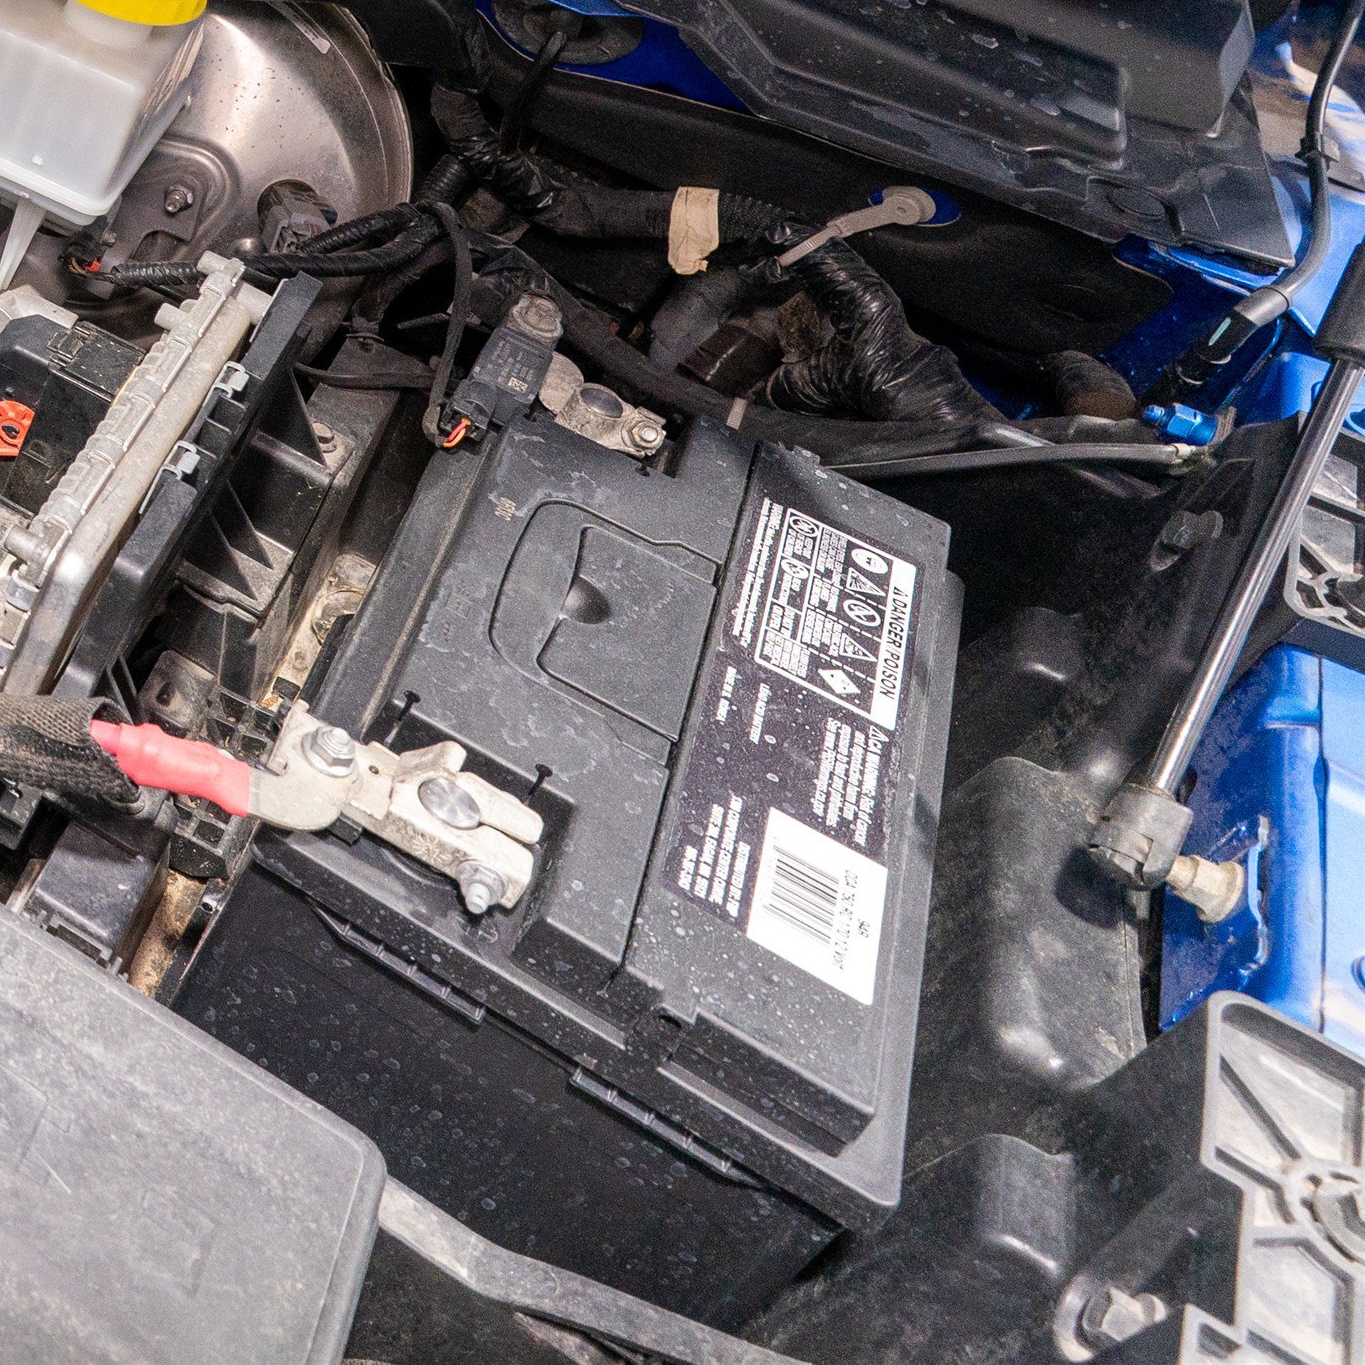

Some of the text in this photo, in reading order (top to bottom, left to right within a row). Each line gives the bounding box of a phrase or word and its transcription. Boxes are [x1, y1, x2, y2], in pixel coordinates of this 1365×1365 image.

[877, 596, 909, 701] DANGER/POISON
[715, 697, 729, 721] KOREA
[749, 682, 770, 744] LEAD ACID BATTERY
[826, 716, 840, 732] See
[837, 723, 851, 755] exposure
[867, 737, 882, 754] CA
[833, 760, 848, 779] lead
[842, 730, 866, 820] and reproductive harm from
[861, 752, 879, 796] WARNING:
[831, 774, 844, 793] and
[858, 794, 874, 813] Risk
[721, 809, 739, 852] CORPORATE
[853, 818, 867, 846] cancer
[715, 849, 731, 880] CENTER
[731, 841, 750, 888] DISTRIBUTED
[843, 868, 858, 891] CCA
[840, 886, 856, 908] 750
[838, 903, 853, 921] RC
[835, 917, 851, 939] 170
[855, 916, 870, 940] 94R
[830, 948, 845, 972] Volt
